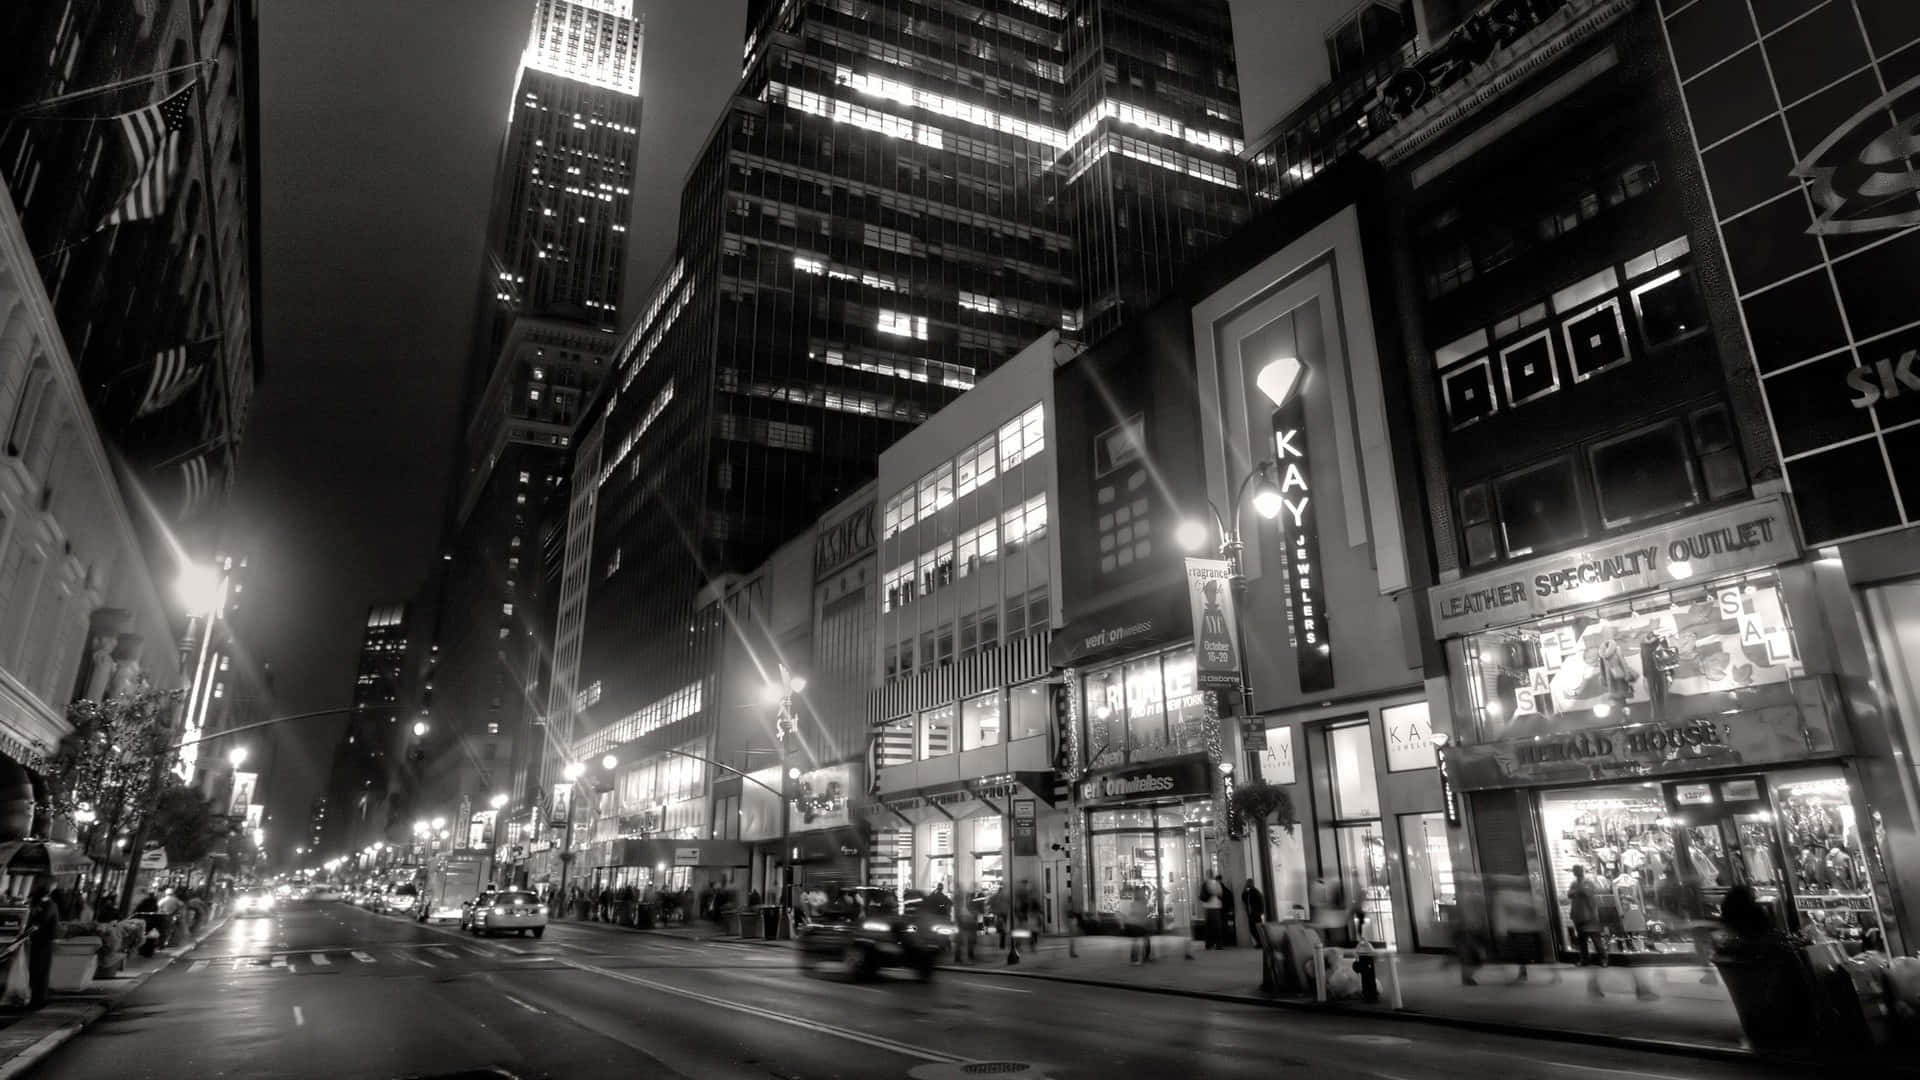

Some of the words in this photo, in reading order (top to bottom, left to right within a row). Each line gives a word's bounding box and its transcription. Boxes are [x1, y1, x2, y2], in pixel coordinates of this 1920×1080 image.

[1275, 429, 1309, 527] KAY
[1296, 534, 1316, 644] JEWELERS
[1438, 581, 1528, 620] LEATHER
[1535, 546, 1658, 599] SPECIALTY
[1668, 516, 1775, 563] OUTLET
[1267, 743, 1289, 761] AY
[1515, 731, 1614, 766] HERALD
[1627, 719, 1721, 754] HOUSE
